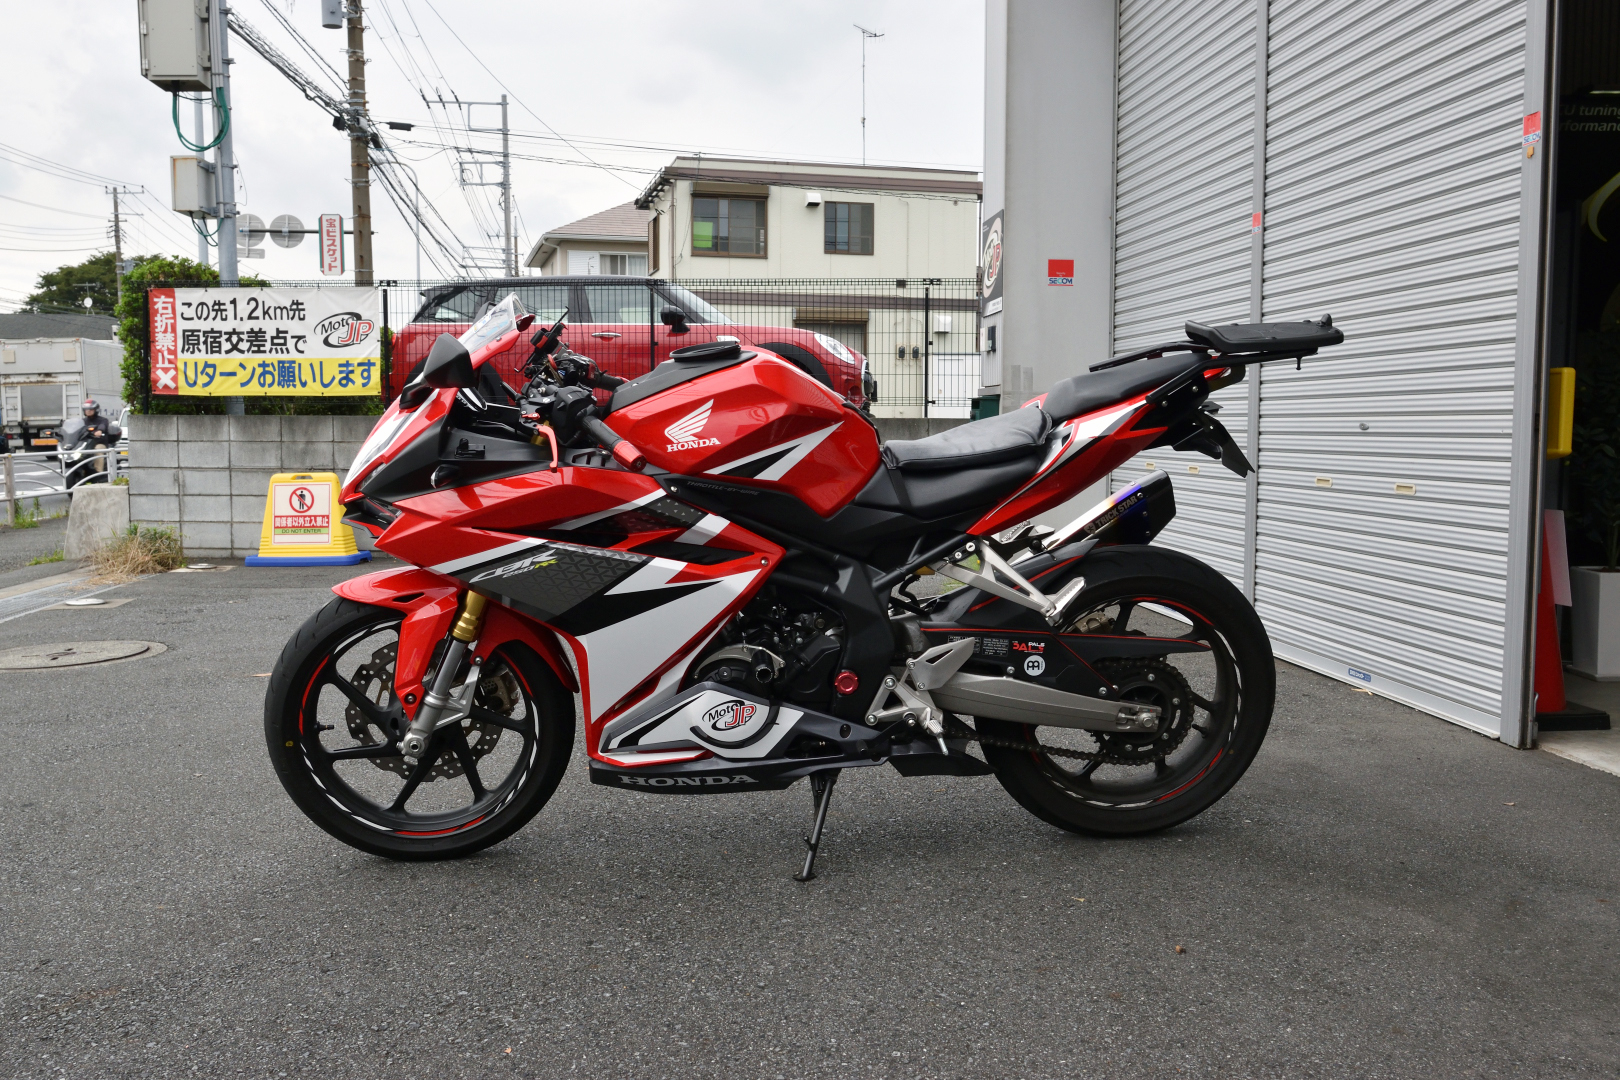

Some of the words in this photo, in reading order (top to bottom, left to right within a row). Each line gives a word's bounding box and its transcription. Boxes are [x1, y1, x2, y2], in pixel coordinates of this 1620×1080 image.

[326, 217, 338, 271] 宝ビスケット
[1048, 277, 1073, 285] SECOM
[180, 296, 306, 322] この先1.2km先
[153, 295, 176, 368] 右折禁止
[180, 327, 308, 355] 原宿交差点で
[338, 318, 374, 345] JP
[183, 358, 376, 389] Uターンお願いします
[666, 437, 721, 453] HONDA
[686, 480, 761, 496] THROTTLE-BY-WIRE
[275, 516, 328, 527] 関係者以外立入禁止
[1095, 508, 1120, 528] TRICK
[1117, 494, 1138, 515] STAR
[469, 549, 557, 583] CBR
[725, 703, 757, 728] JP
[618, 774, 760, 787] HONDA
